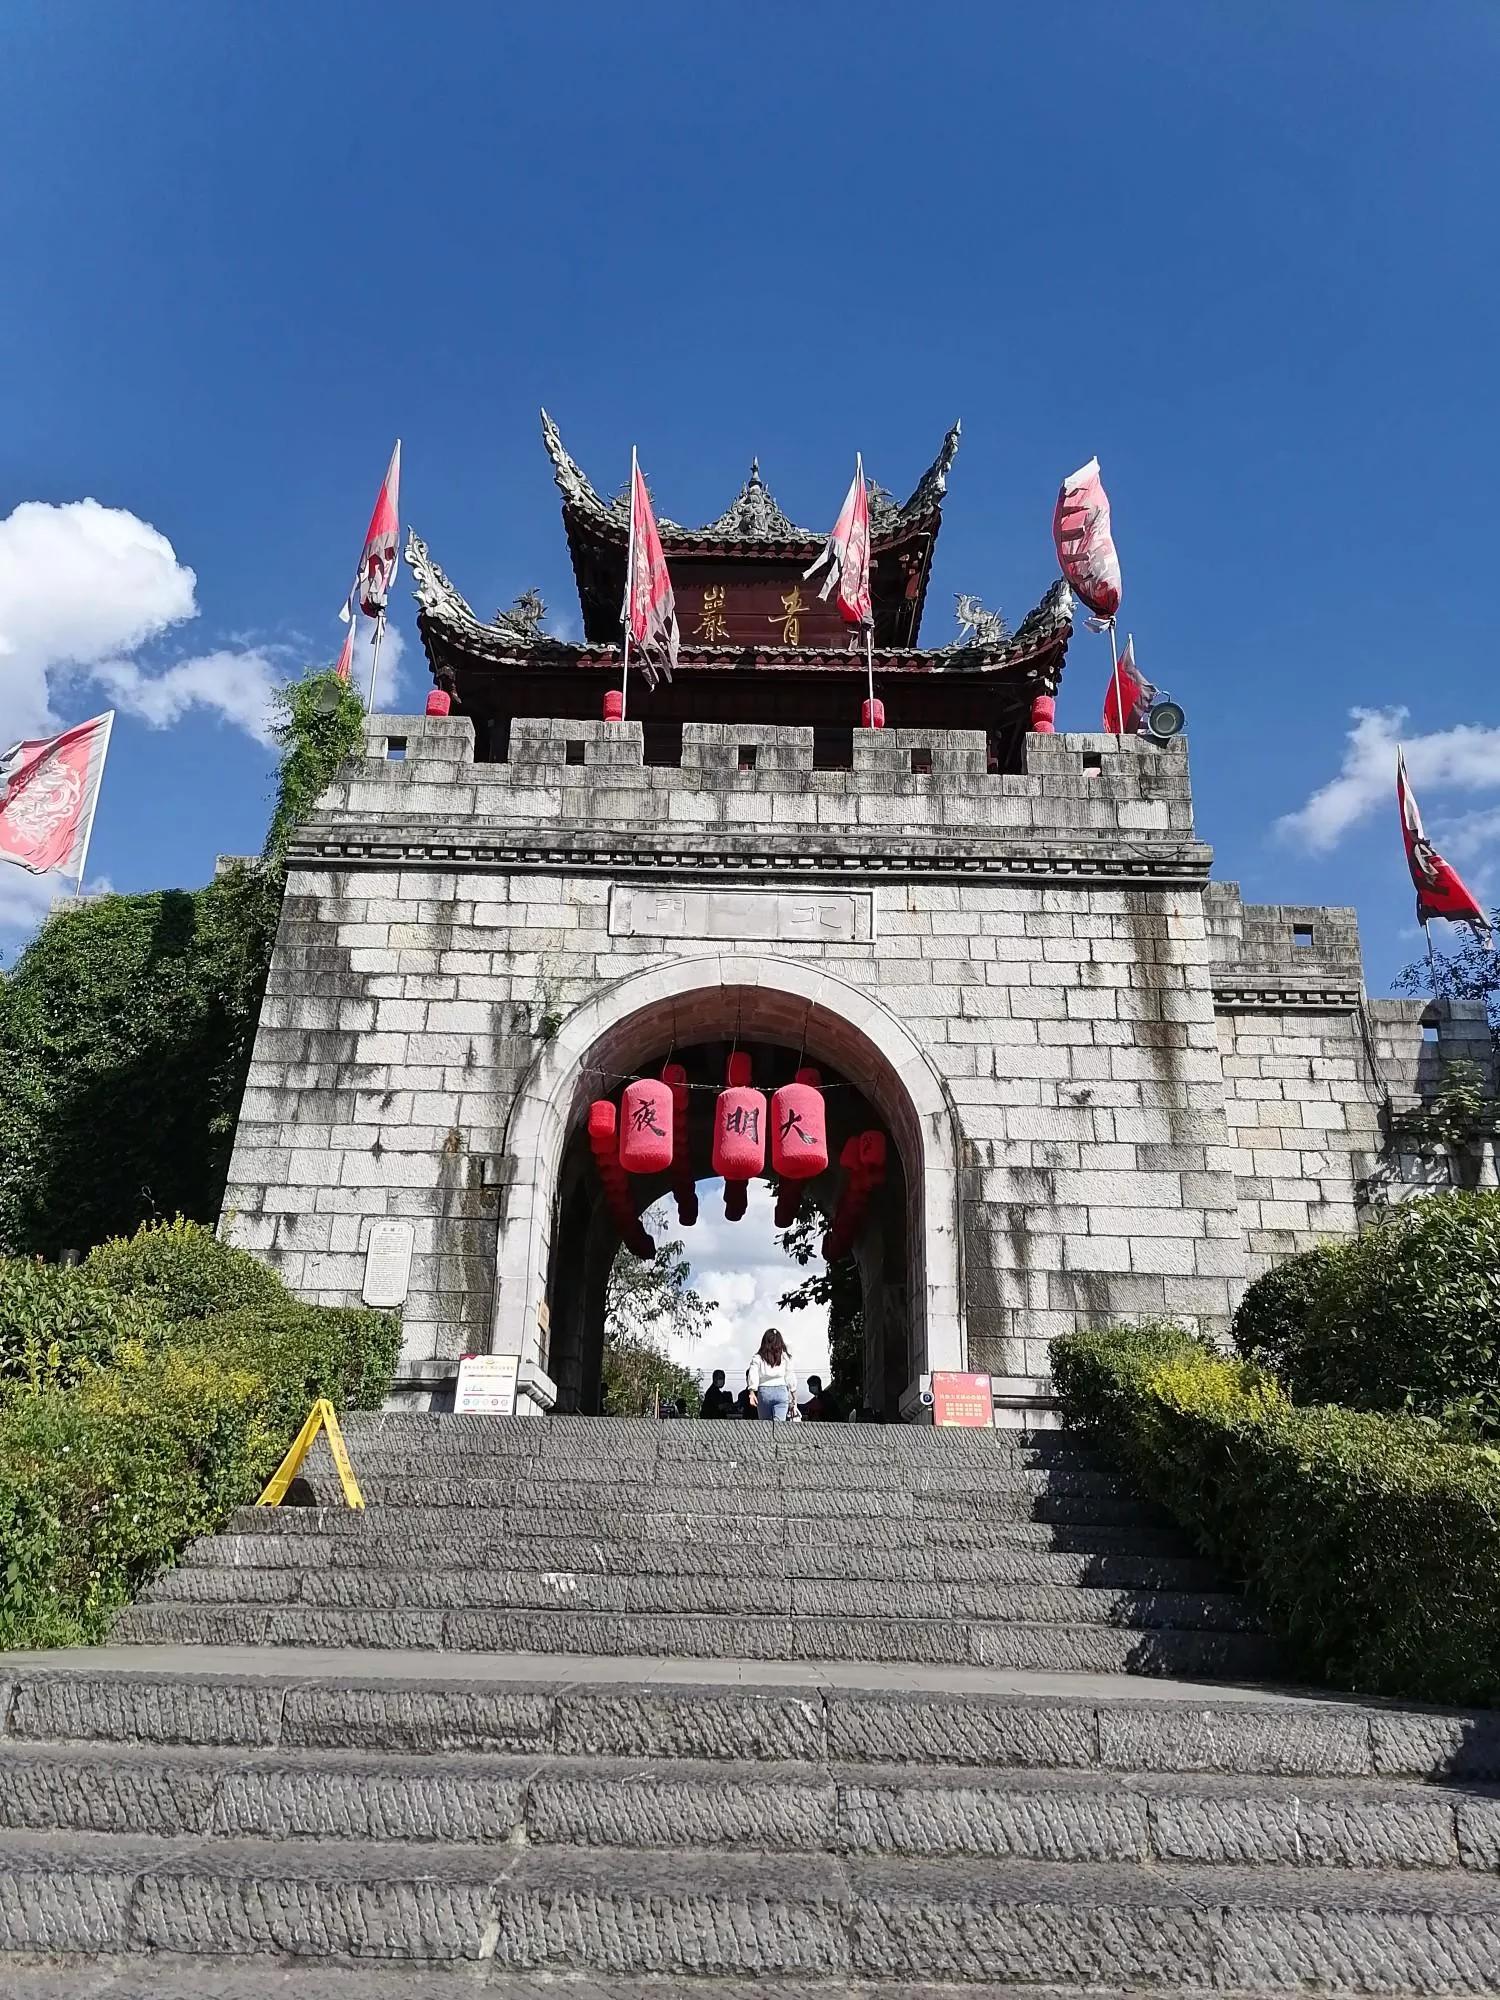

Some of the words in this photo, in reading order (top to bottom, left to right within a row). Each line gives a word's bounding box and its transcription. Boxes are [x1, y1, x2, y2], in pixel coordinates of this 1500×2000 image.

[631, 1098, 666, 1137] 夜
[726, 1106, 760, 1145] 明
[779, 1108, 818, 1145] 大
